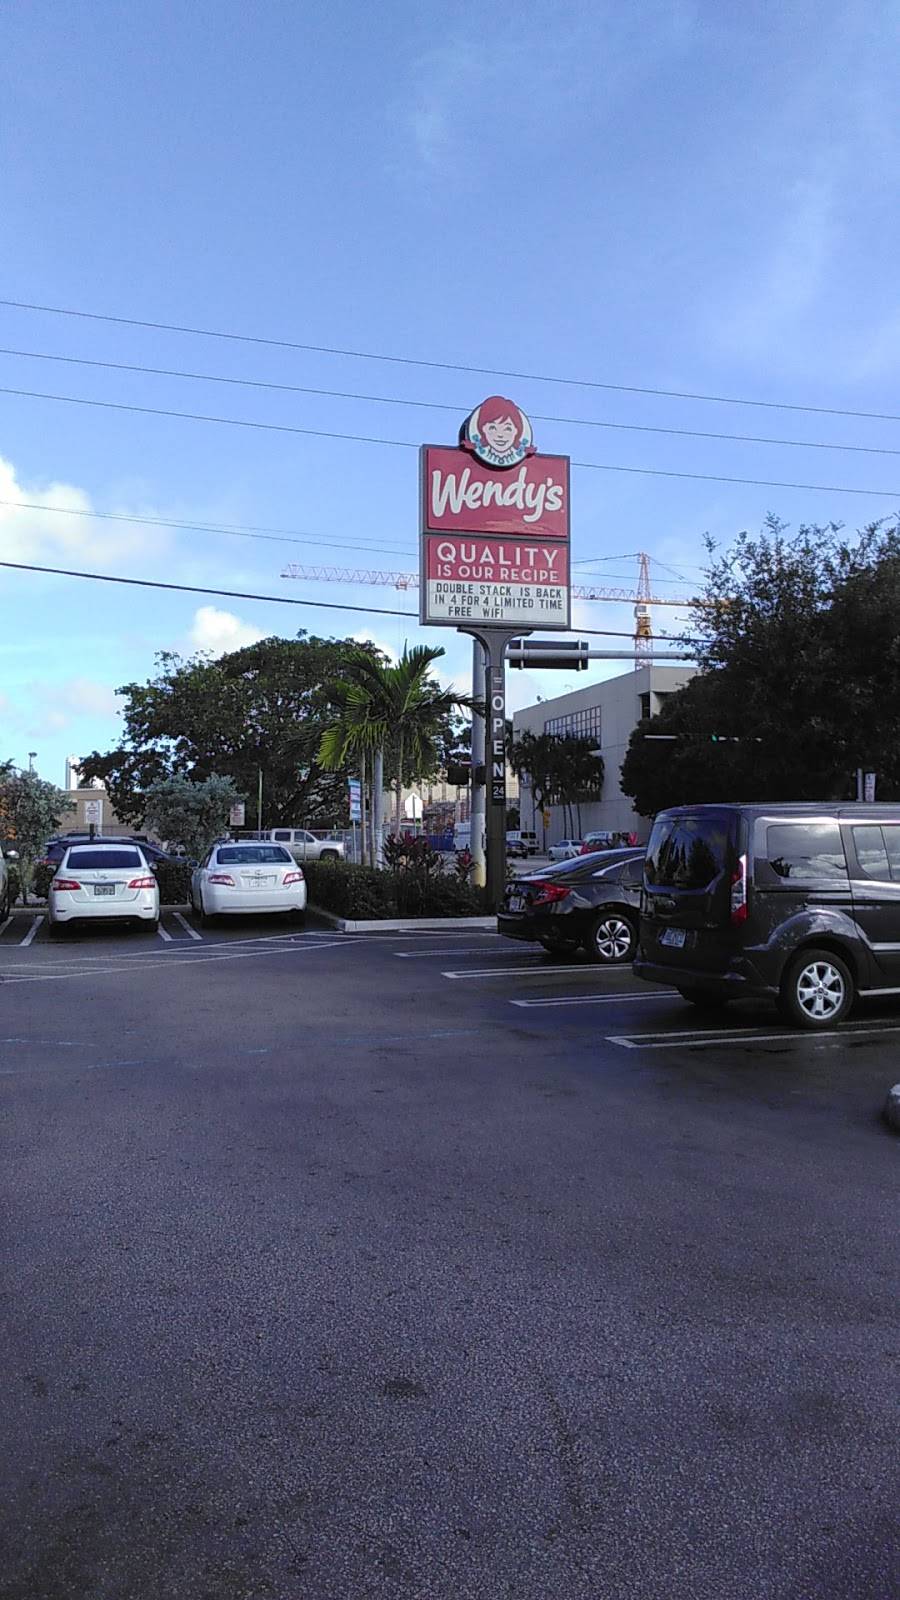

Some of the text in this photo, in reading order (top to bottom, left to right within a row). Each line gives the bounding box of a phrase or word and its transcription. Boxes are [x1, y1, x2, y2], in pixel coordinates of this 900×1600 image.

[432, 466, 564, 523] Wendy's
[437, 542, 558, 568] QUALITY
[437, 564, 558, 583] IS OUR RECIPE
[436, 582, 562, 599] DOUBLE STACK IS BACK
[434, 594, 563, 610] IN 4 FOR 4 LIMITED TIME
[448, 605, 504, 619] FREE WIFI
[491, 695, 505, 778] OPEN
[493, 785, 505, 796] 24
